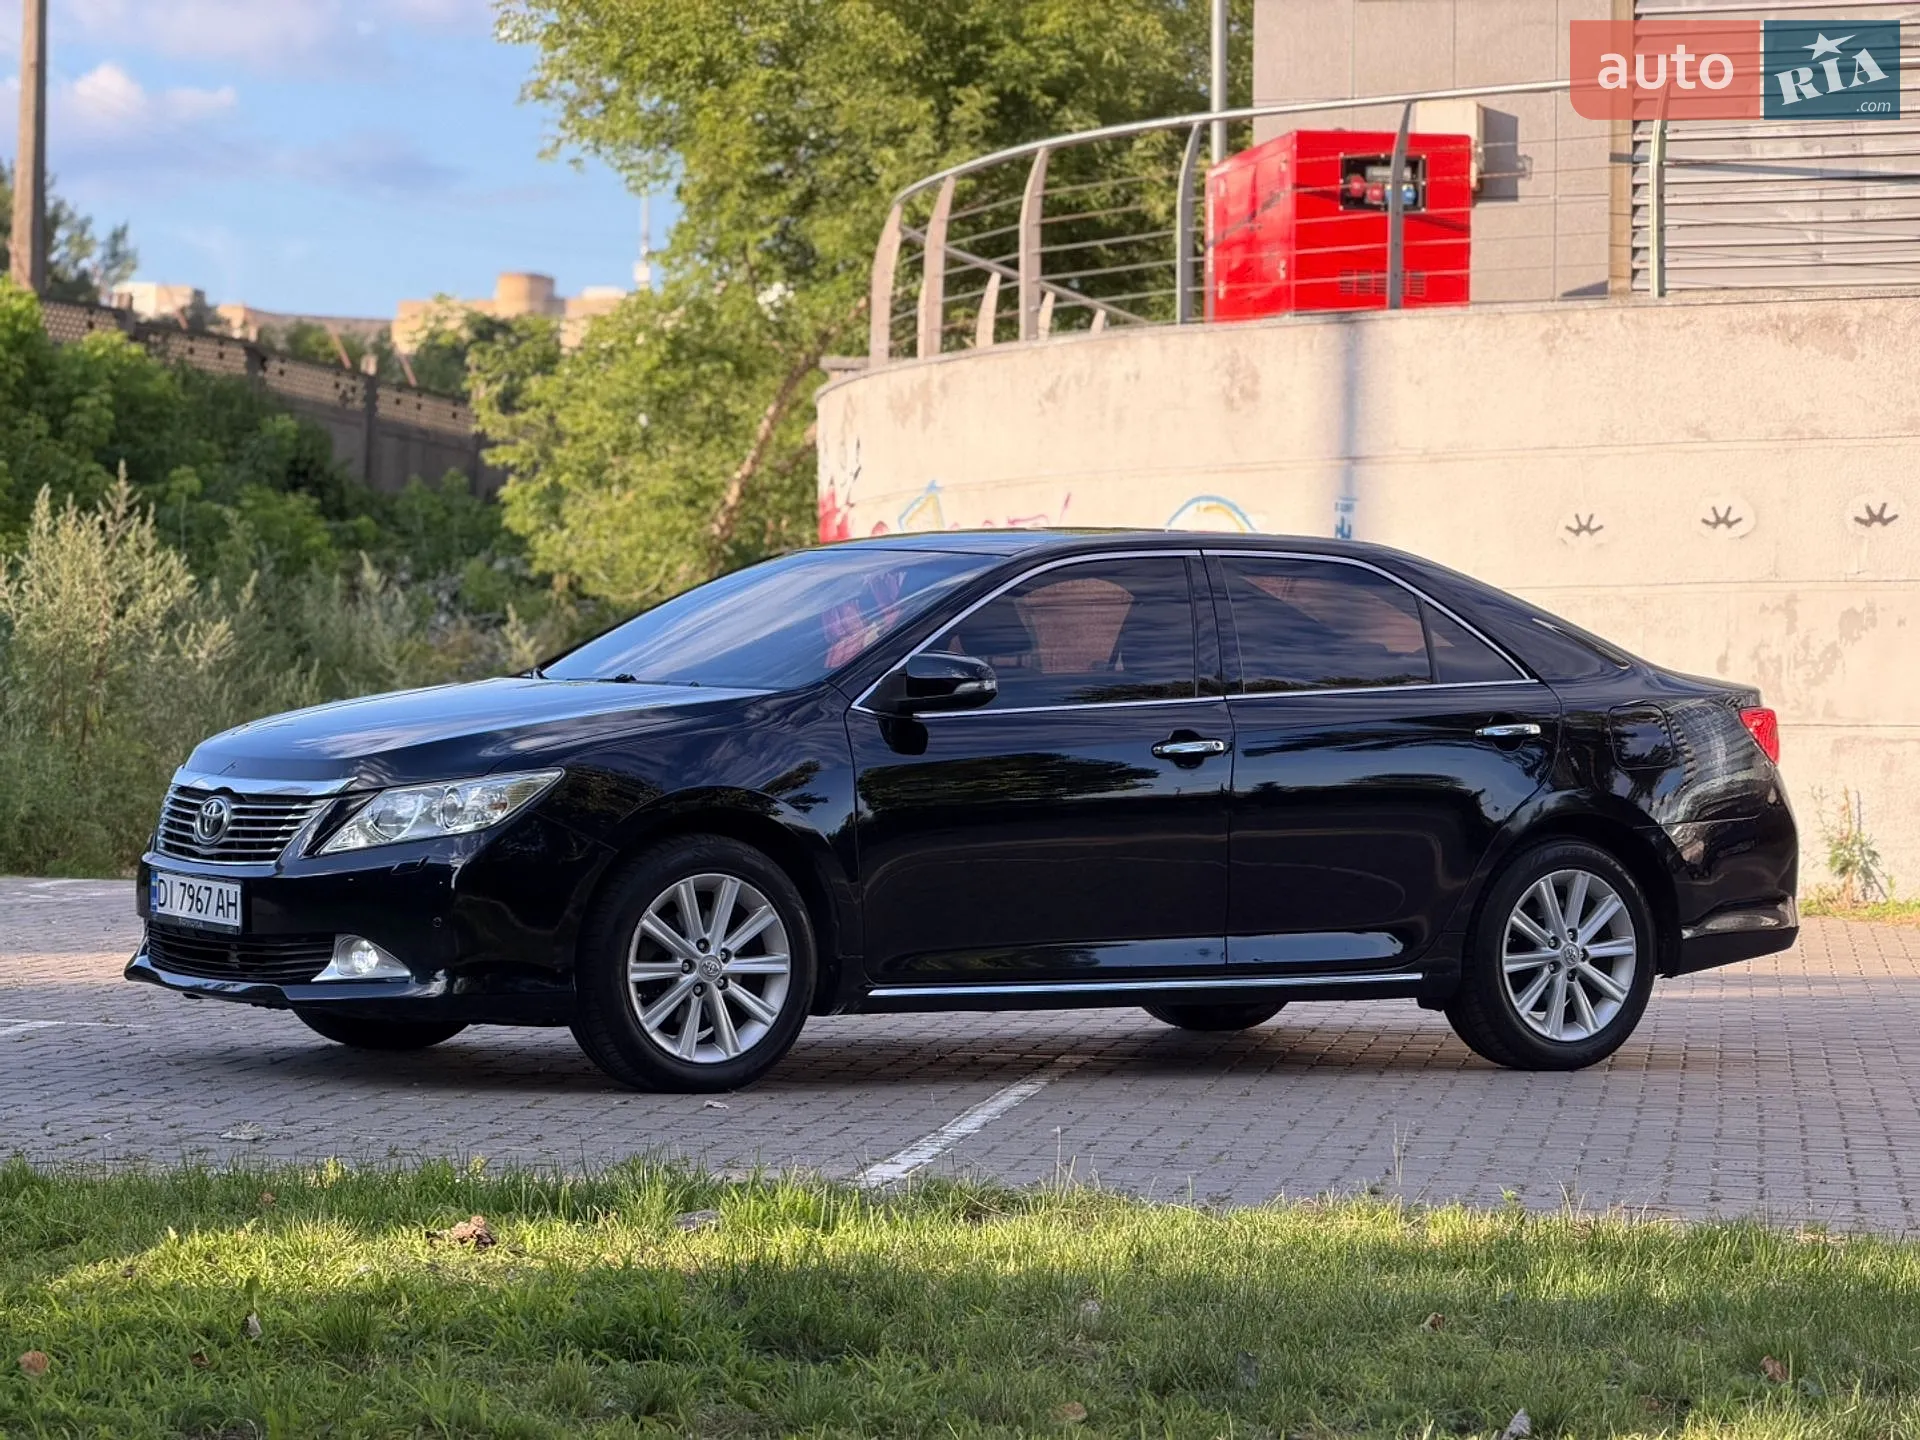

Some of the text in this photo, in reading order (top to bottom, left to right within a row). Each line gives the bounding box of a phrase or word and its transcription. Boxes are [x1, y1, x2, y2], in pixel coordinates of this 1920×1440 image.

[158, 879, 238, 920] DI 7967 AH
